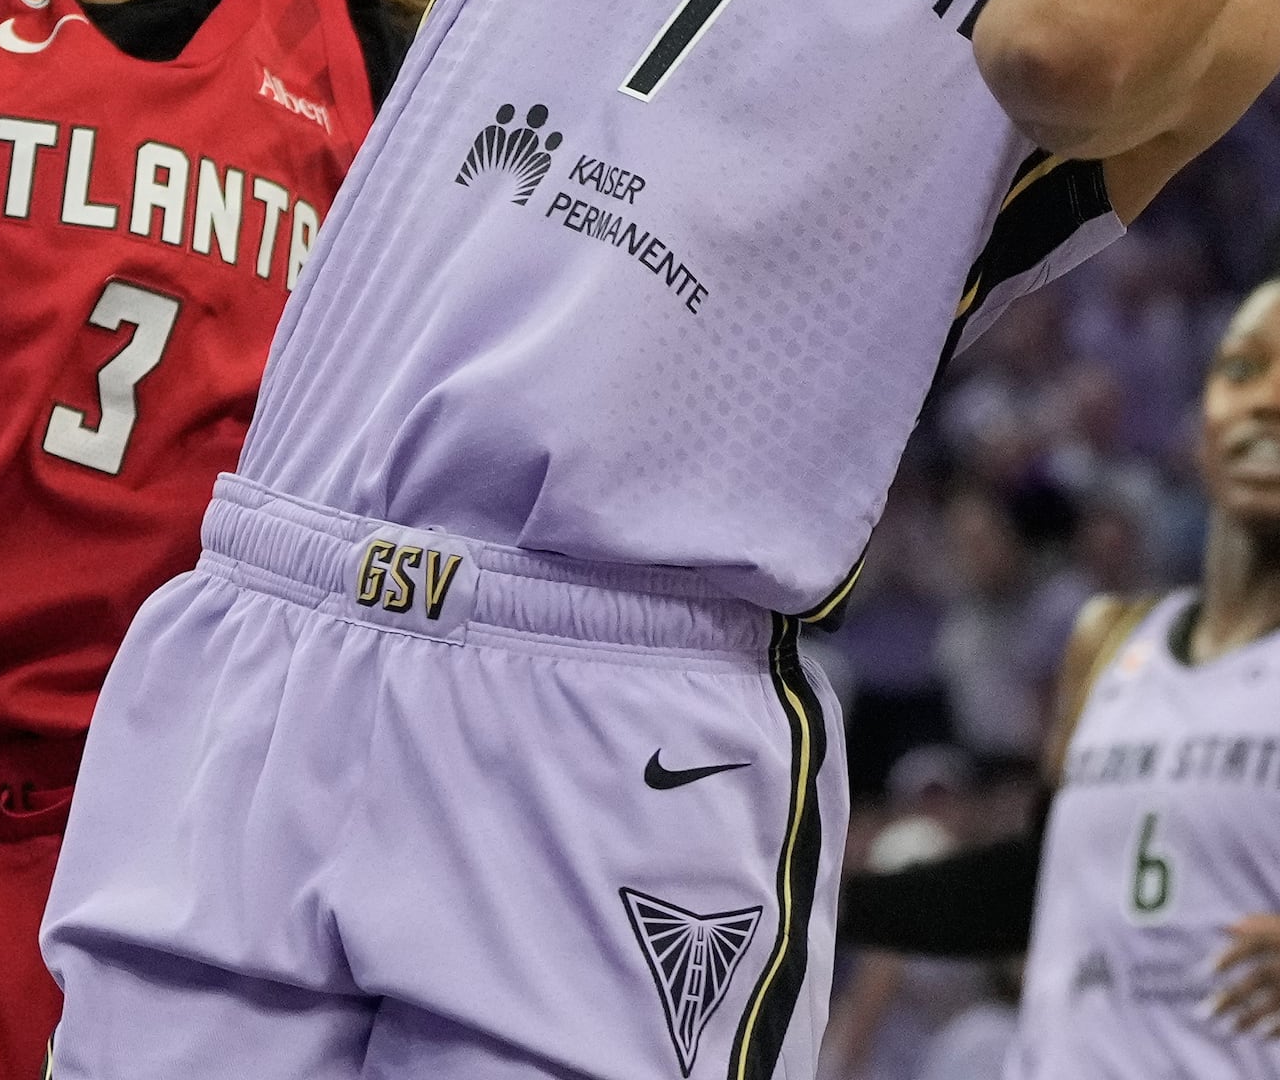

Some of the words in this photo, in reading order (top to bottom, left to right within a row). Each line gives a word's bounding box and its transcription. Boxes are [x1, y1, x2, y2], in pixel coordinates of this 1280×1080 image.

[569, 155, 646, 204] KAISER
[545, 192, 710, 315] PERMANENTE
[42, 274, 181, 476] 3
[355, 538, 462, 620] GSV
[1131, 812, 1171, 915] 6
